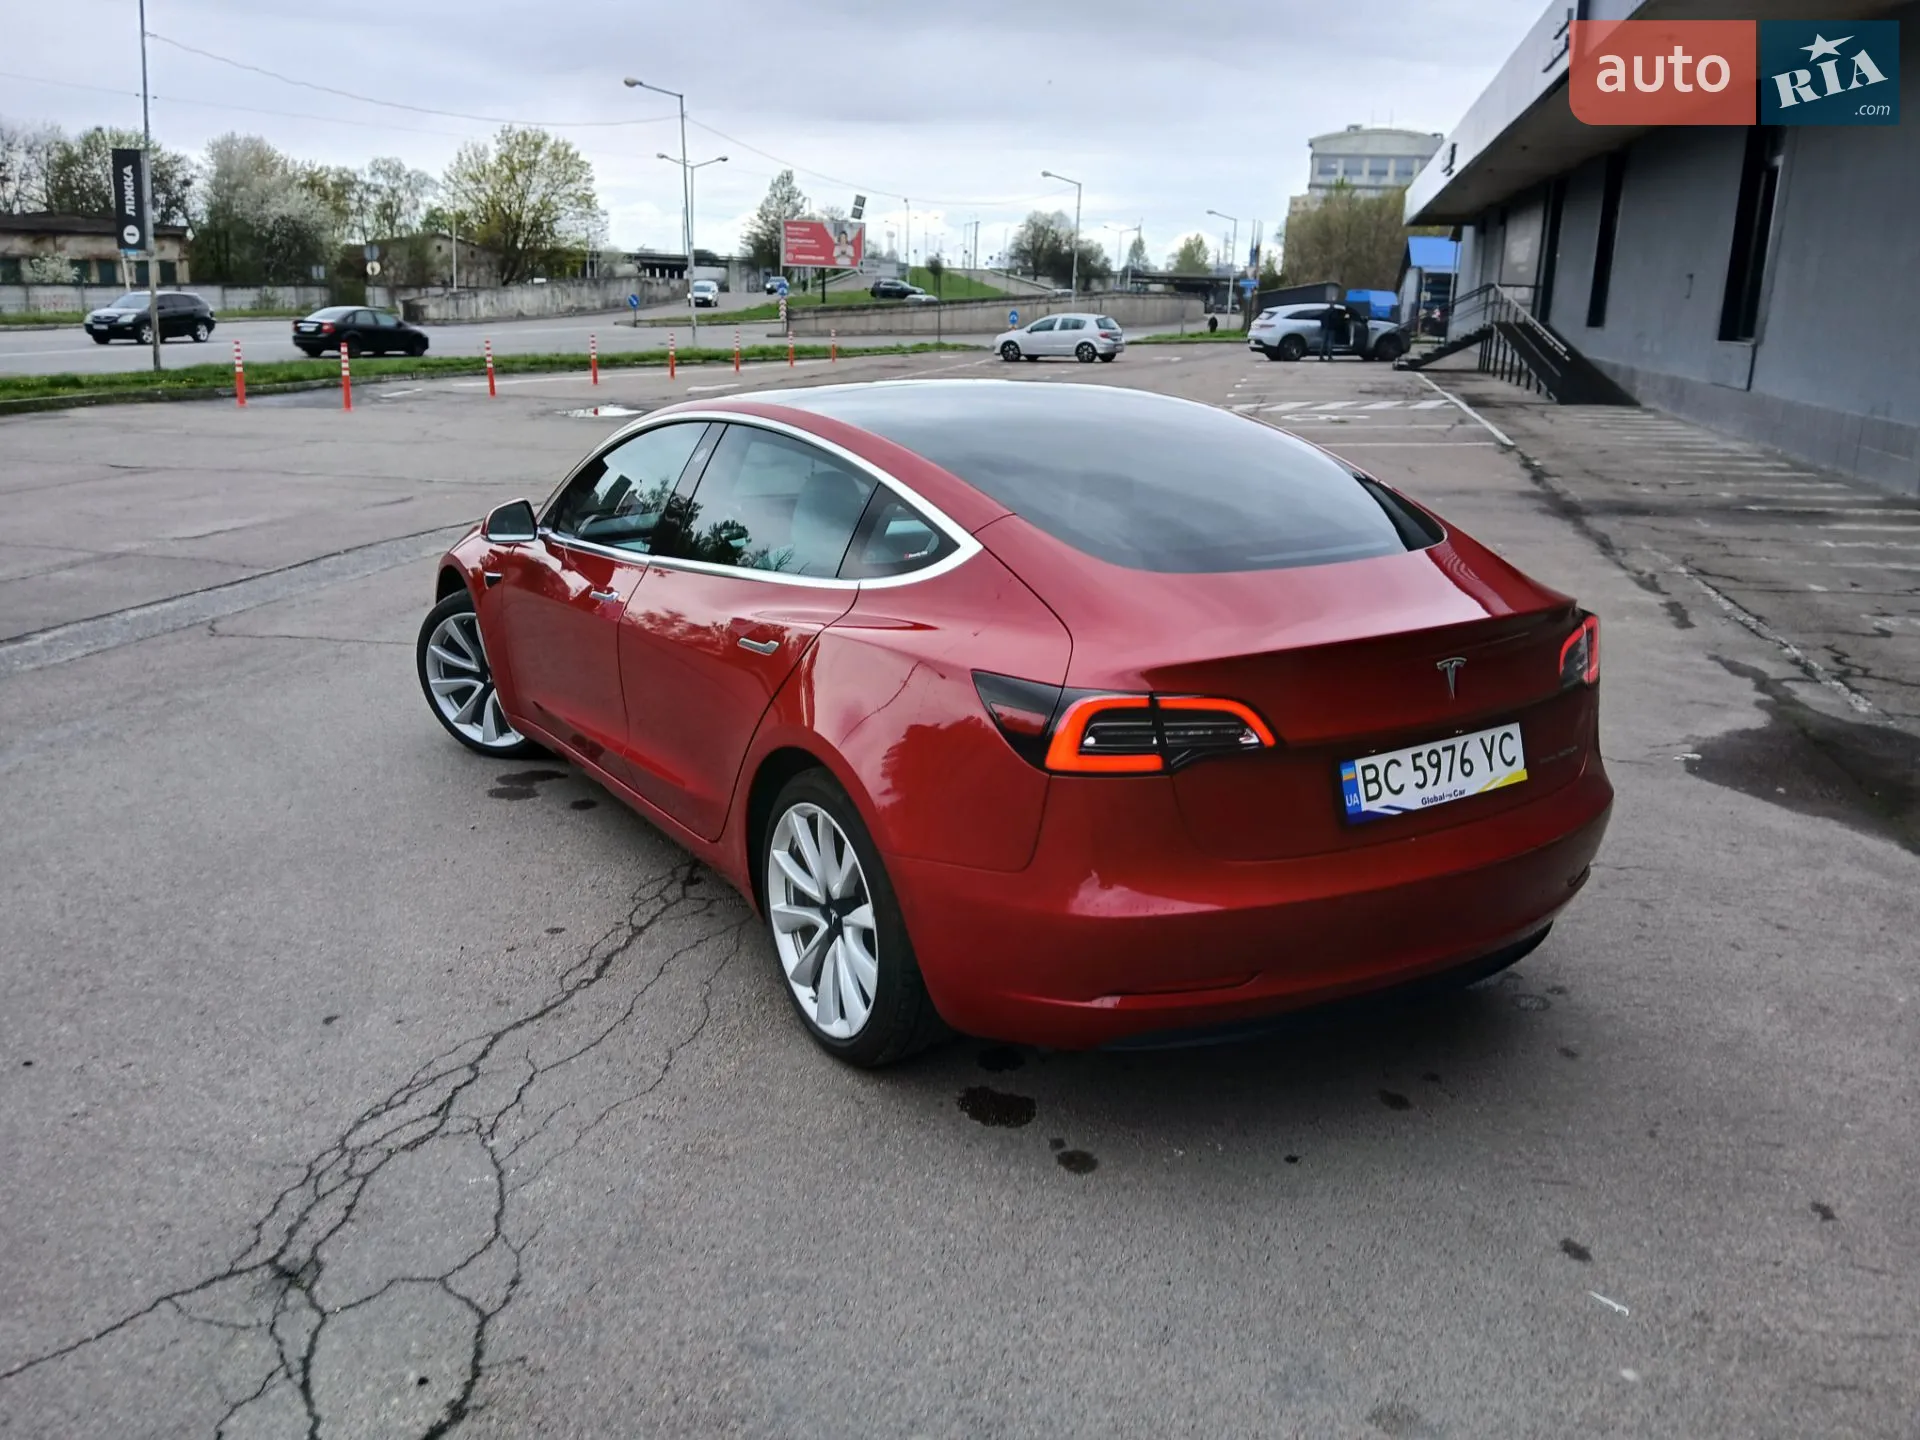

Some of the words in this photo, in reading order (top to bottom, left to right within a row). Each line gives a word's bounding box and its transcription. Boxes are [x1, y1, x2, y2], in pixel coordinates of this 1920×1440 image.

[122, 164, 136, 217] ЛІЖКА
[1361, 758, 1405, 803] BC
[1411, 741, 1474, 789] 5976
[1479, 731, 1517, 772] YC
[1345, 793, 1360, 807] UA
